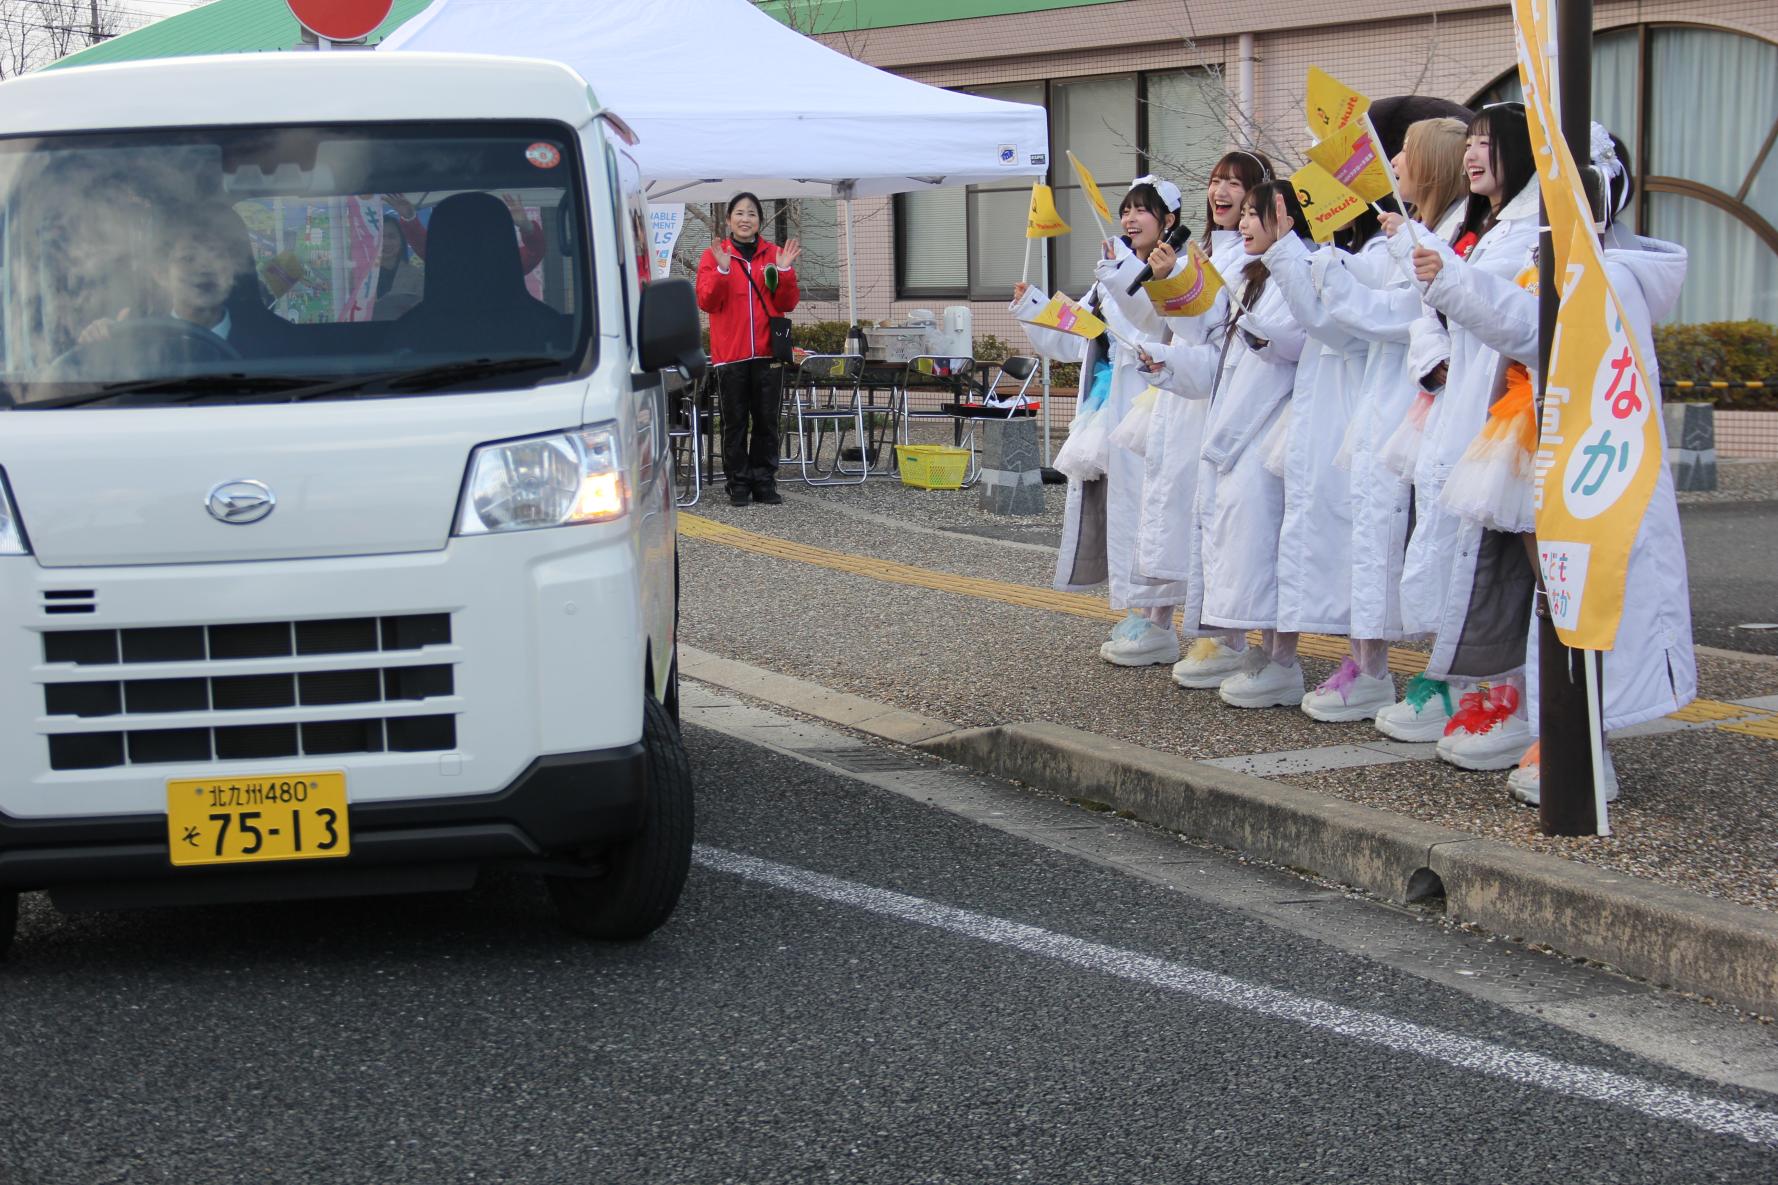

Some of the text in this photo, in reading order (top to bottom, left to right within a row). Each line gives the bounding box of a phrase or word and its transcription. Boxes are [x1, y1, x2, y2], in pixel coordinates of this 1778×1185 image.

[651, 212, 678, 221] ABLE
[1314, 196, 1358, 223] Yakult
[655, 232, 673, 244] LS
[1570, 346, 1642, 496] なか
[182, 808, 339, 856] そ 75-13
